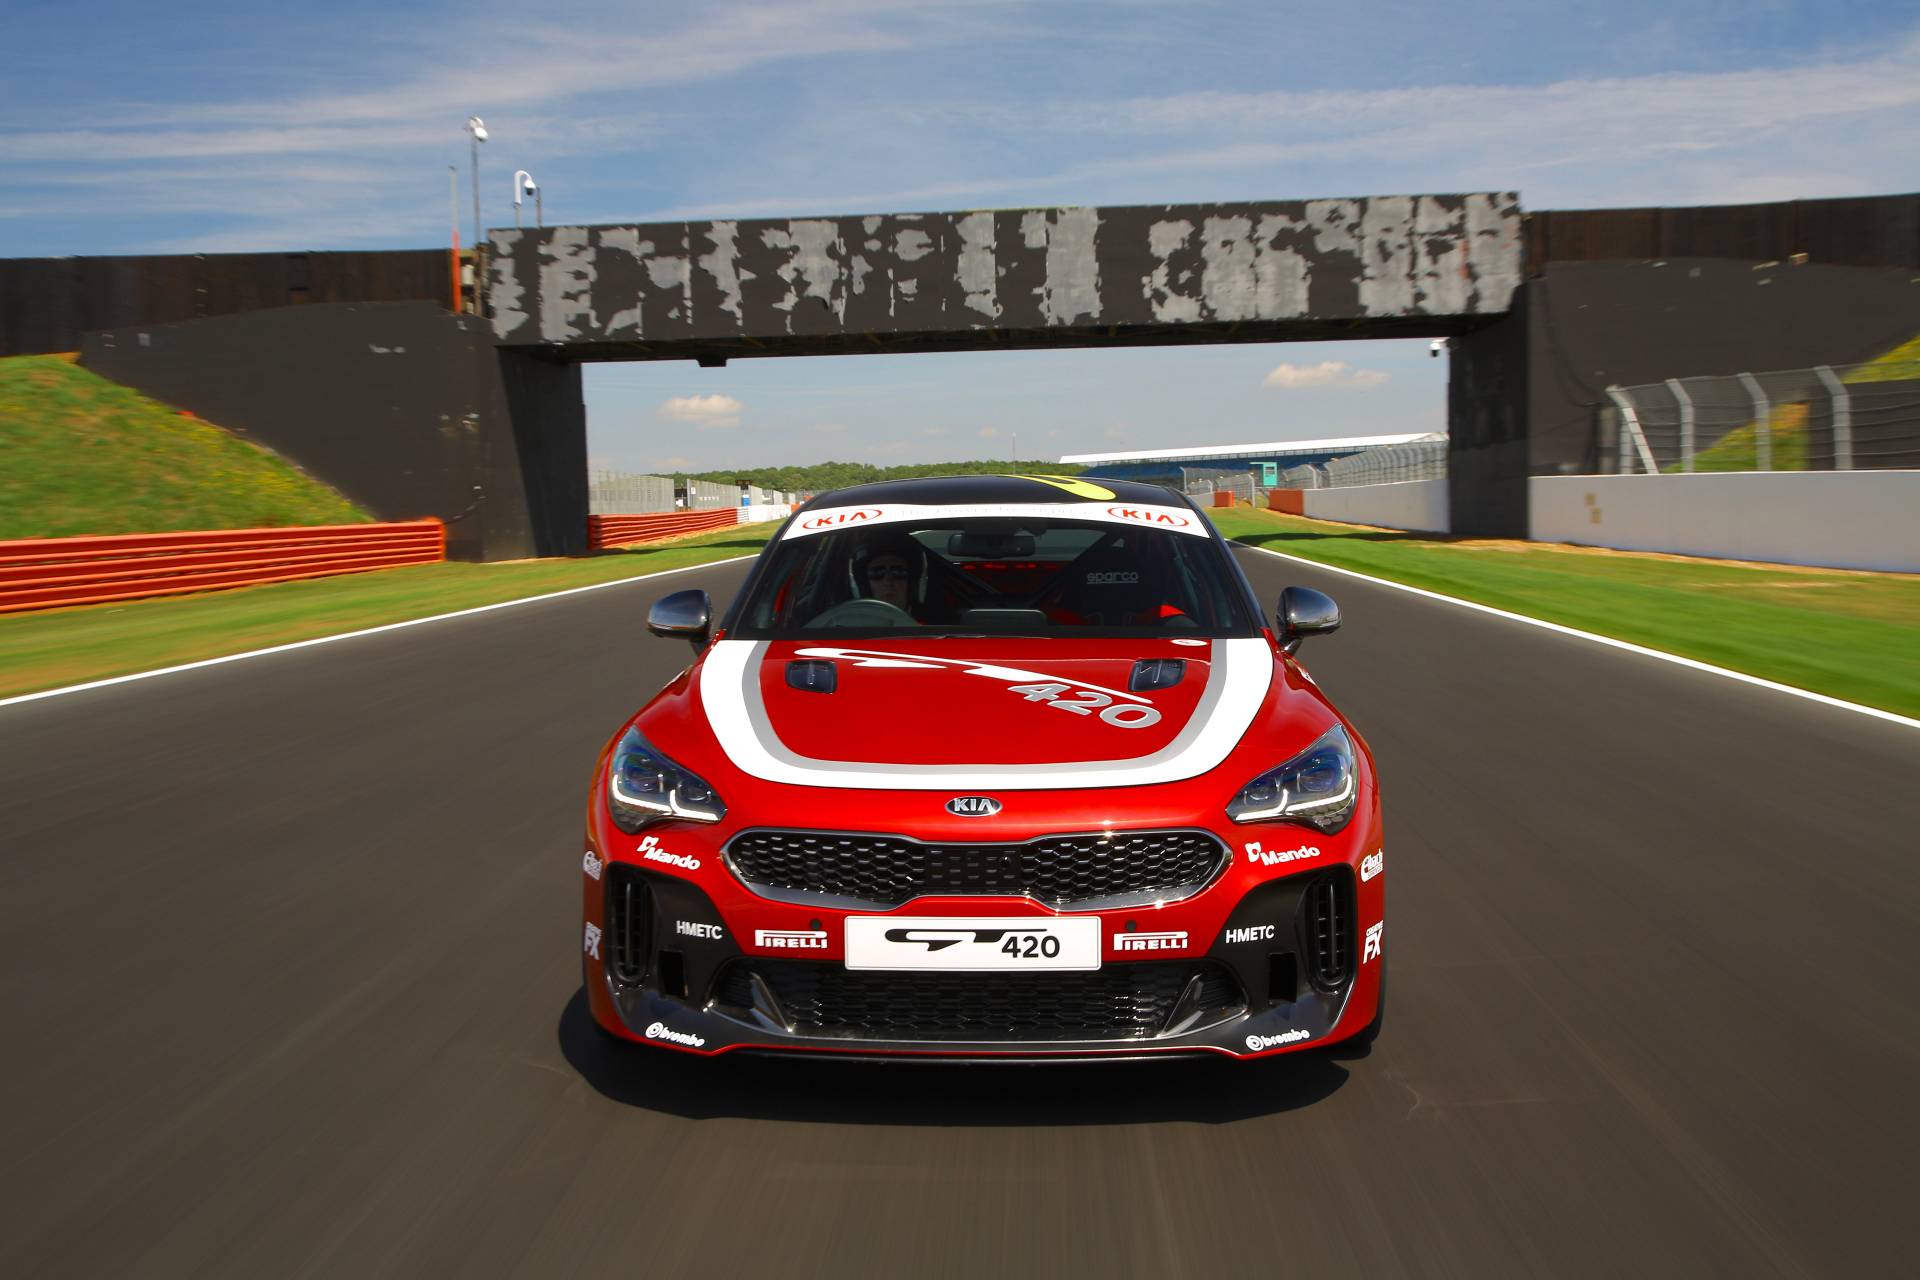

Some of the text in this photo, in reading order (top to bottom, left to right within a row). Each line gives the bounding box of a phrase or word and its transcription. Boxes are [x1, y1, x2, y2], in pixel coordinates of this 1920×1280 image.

[816, 511, 867, 527] KIA
[1122, 509, 1175, 524] KIA
[1086, 571, 1139, 584] sparco
[1007, 682, 1163, 729] 420
[954, 797, 996, 814] KIA
[643, 846, 701, 870] Mando
[1260, 845, 1321, 866] Mando
[676, 920, 722, 940] HMETC
[754, 929, 828, 949] PIRELLI
[1225, 924, 1276, 944] HMETC
[1001, 935, 1060, 959] 420
[1113, 931, 1189, 951] PIRELLI
[1362, 929, 1384, 964] FX
[659, 1026, 705, 1047] brembo
[1260, 1029, 1310, 1047] brembo
